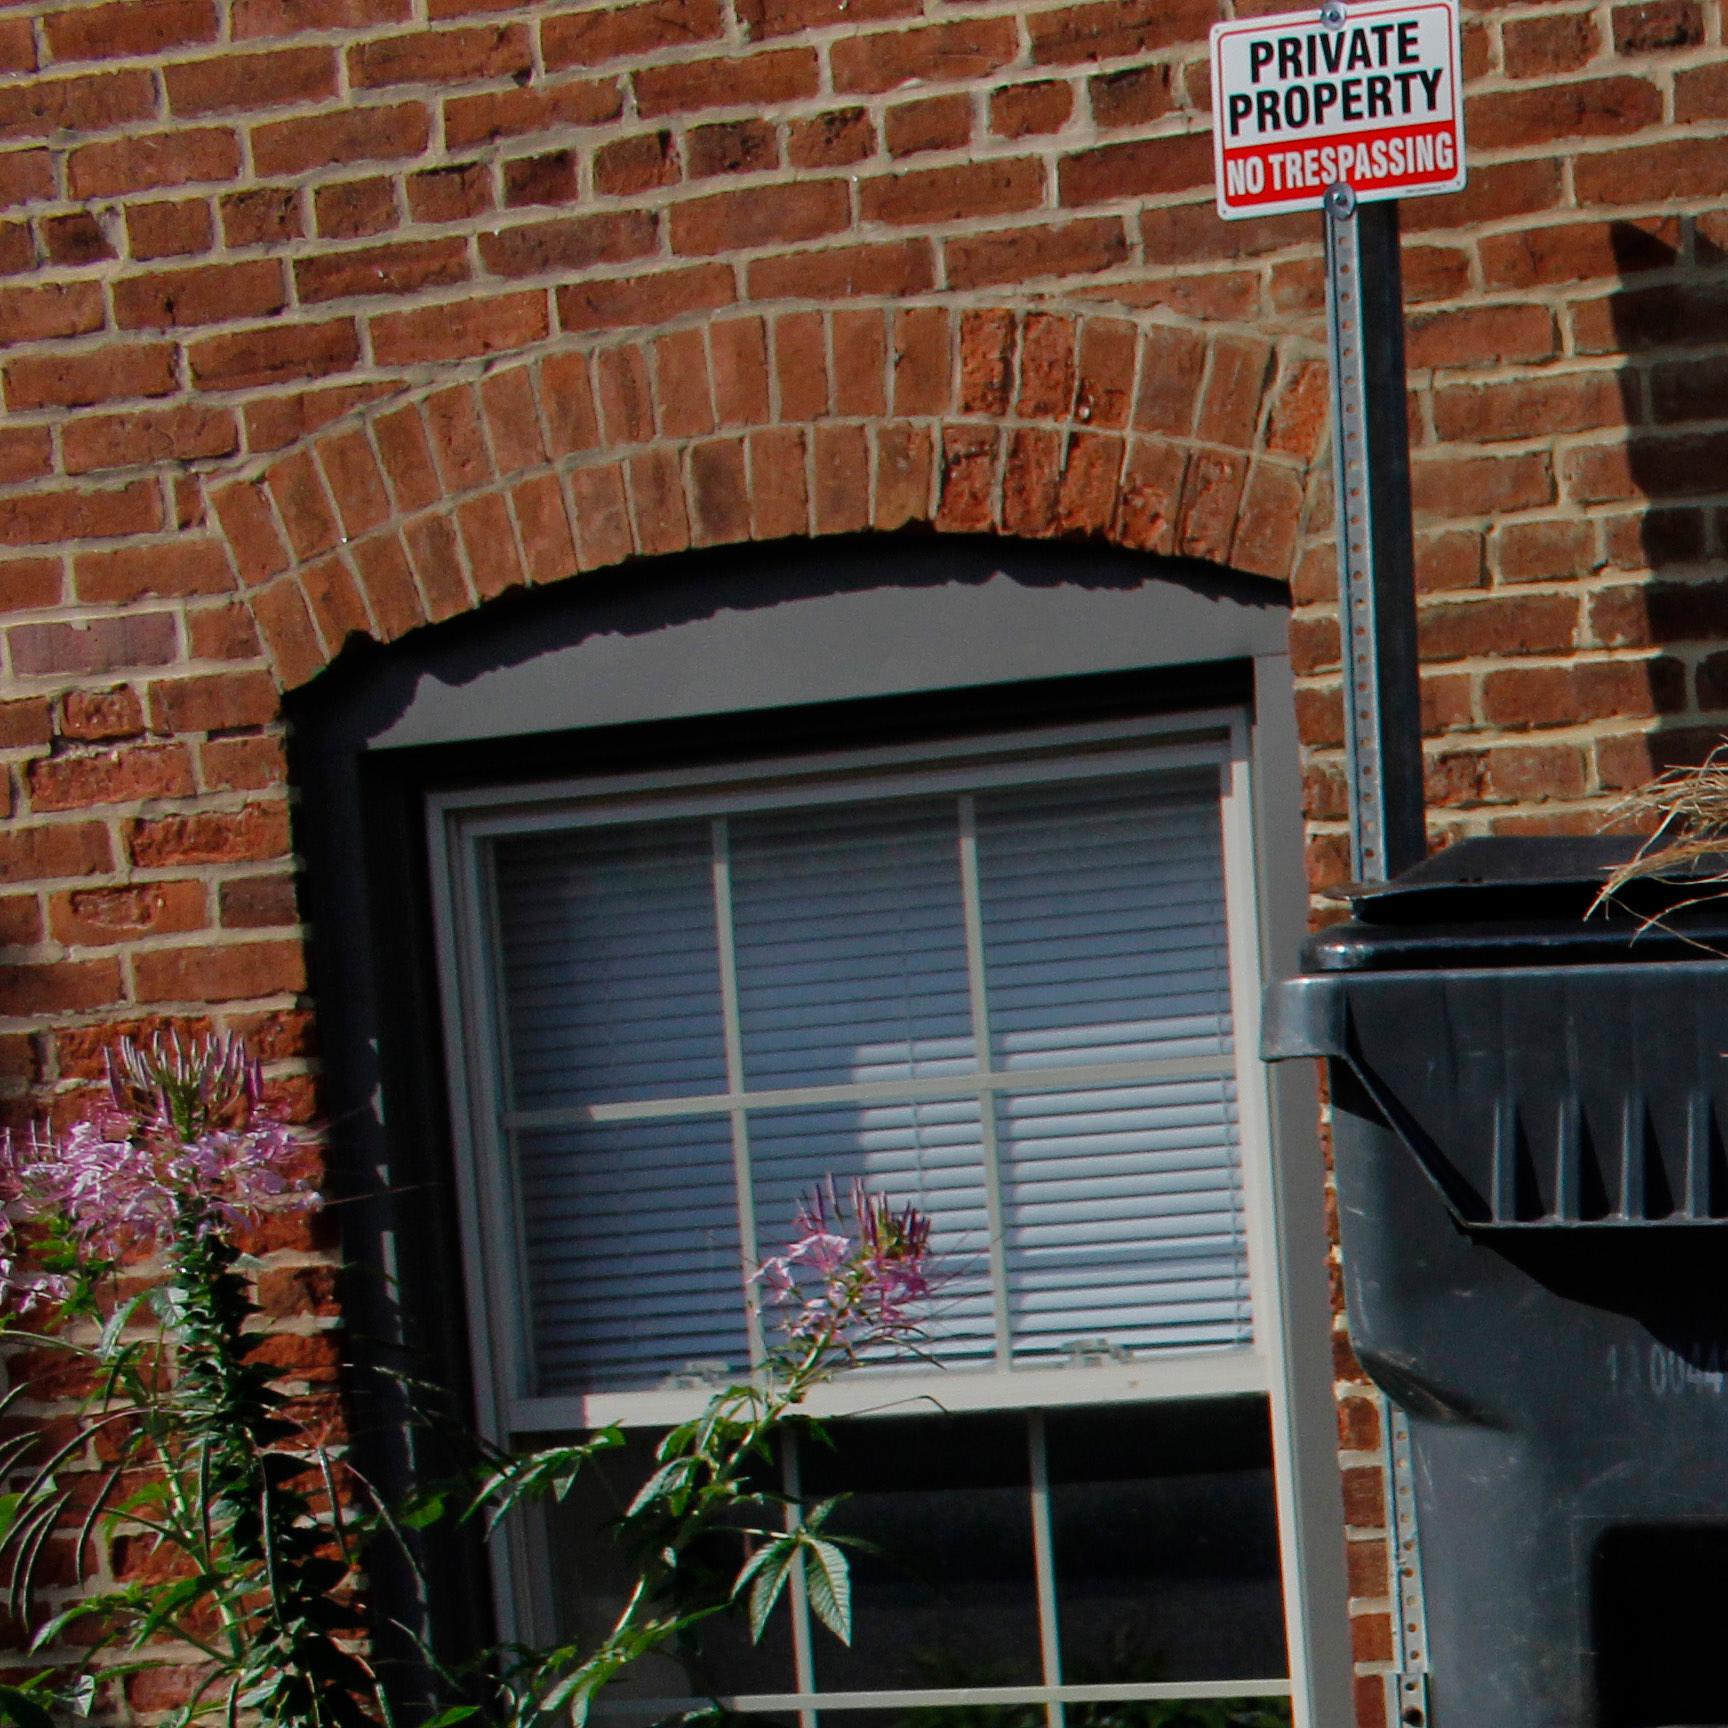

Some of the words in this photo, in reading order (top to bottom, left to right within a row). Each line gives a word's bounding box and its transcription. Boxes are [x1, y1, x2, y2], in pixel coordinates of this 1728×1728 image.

[1250, 21, 1419, 83] PRIVATE
[1229, 68, 1443, 136] PROPERTY
[1226, 154, 1265, 196] NO
[1271, 130, 1454, 188] TRESPASSING
